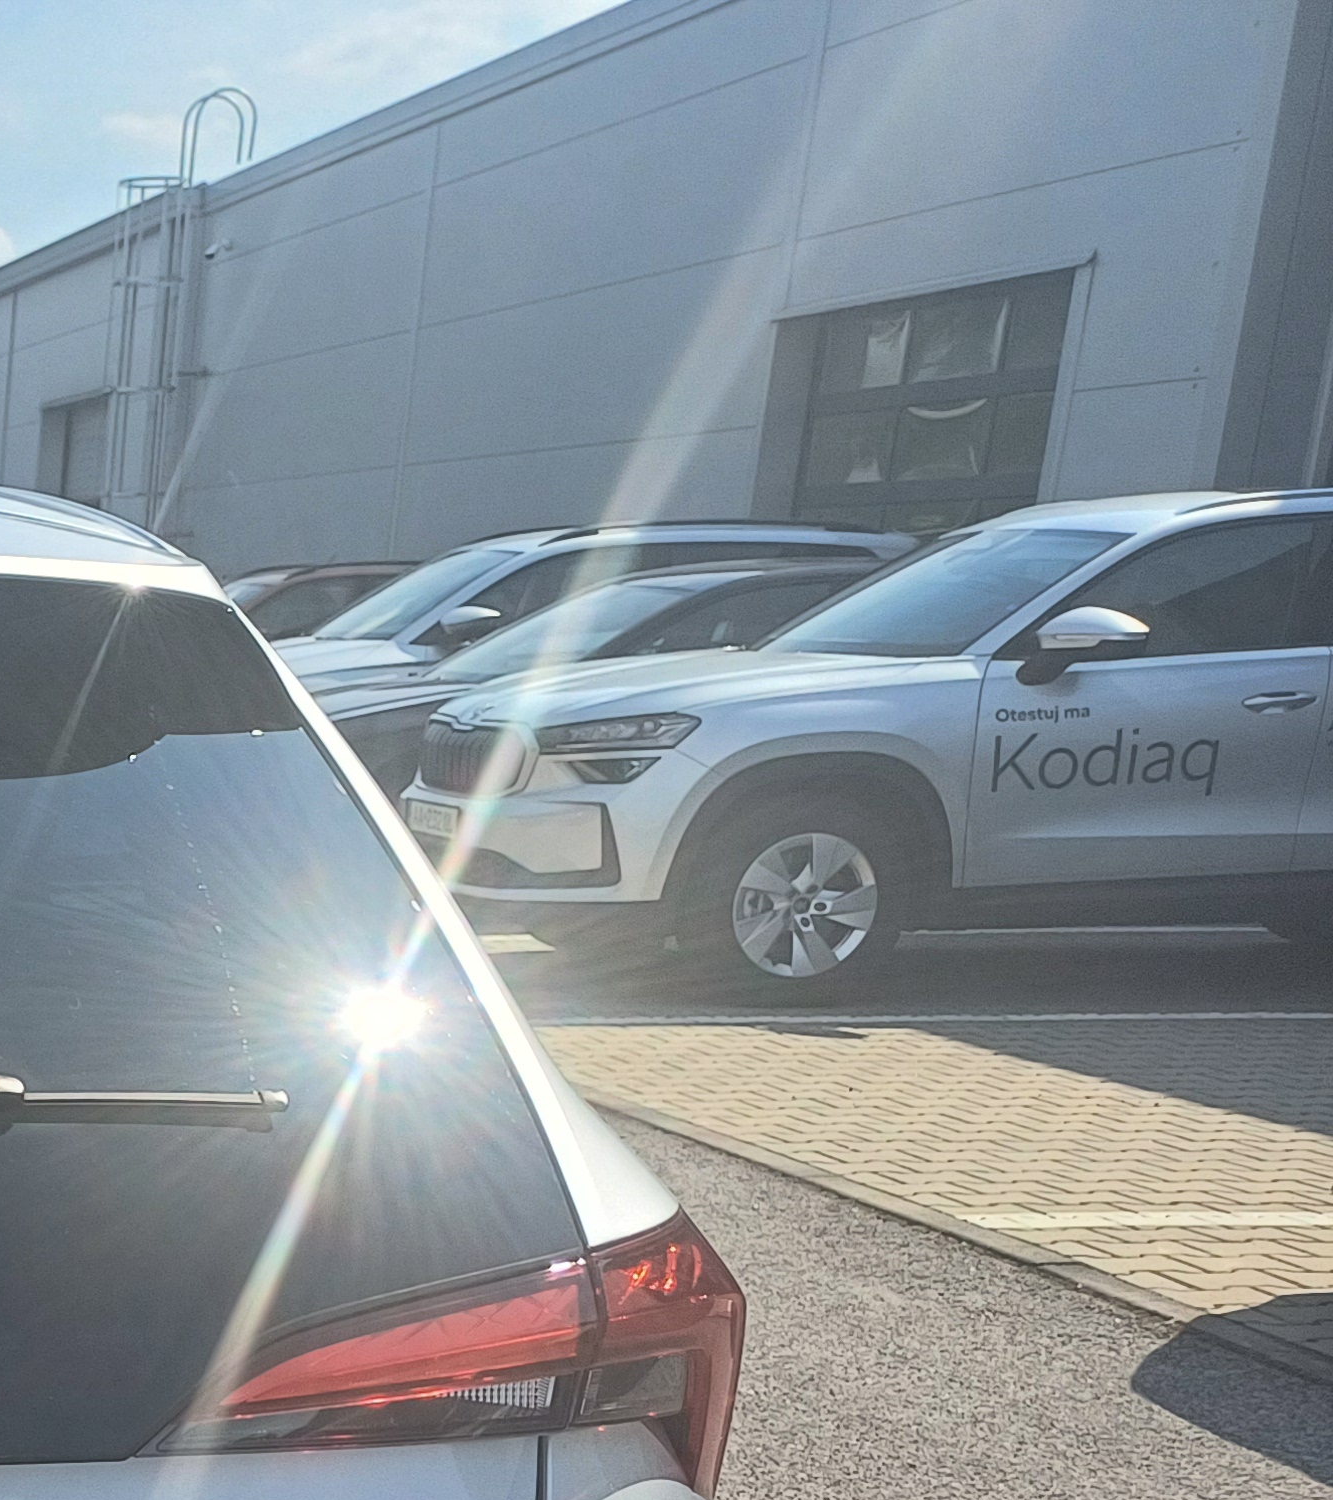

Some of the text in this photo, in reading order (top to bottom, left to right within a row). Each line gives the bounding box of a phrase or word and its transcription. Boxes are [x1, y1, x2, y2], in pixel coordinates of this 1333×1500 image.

[995, 705, 1091, 724] Otestuj ma
[990, 727, 1221, 797] Kodiaq
